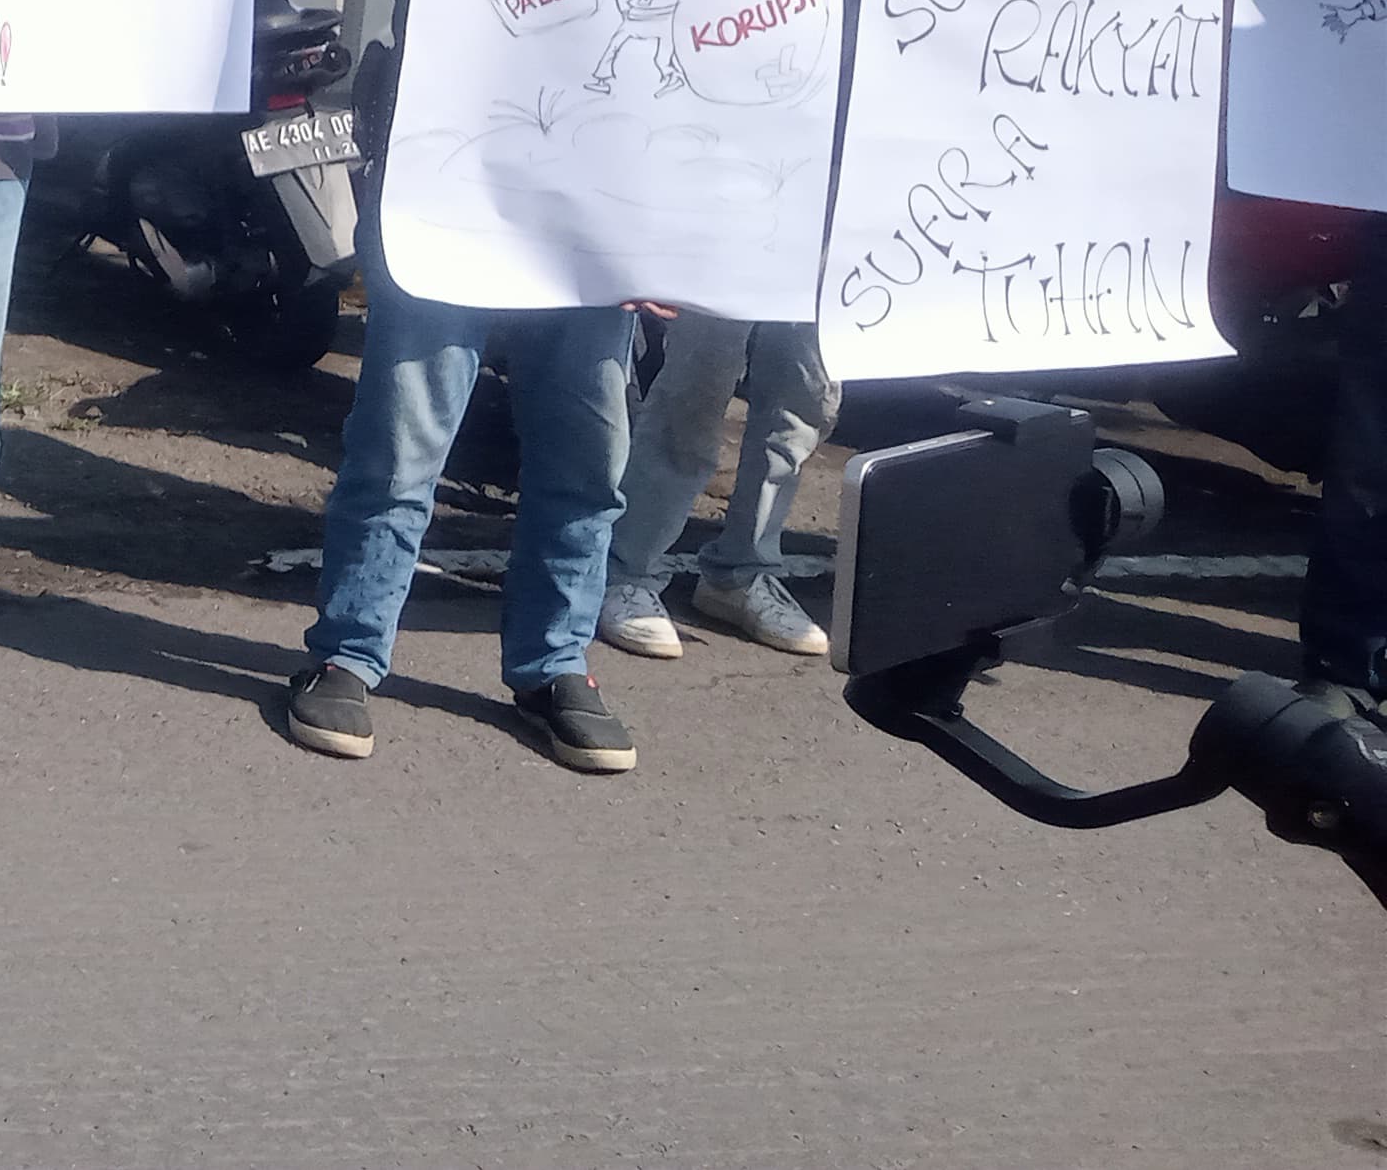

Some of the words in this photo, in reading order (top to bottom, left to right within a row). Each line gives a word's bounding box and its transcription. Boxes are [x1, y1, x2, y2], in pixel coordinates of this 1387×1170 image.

[248, 131, 272, 153] AE
[279, 120, 324, 146] 4304
[840, 114, 1049, 331] SUARA
